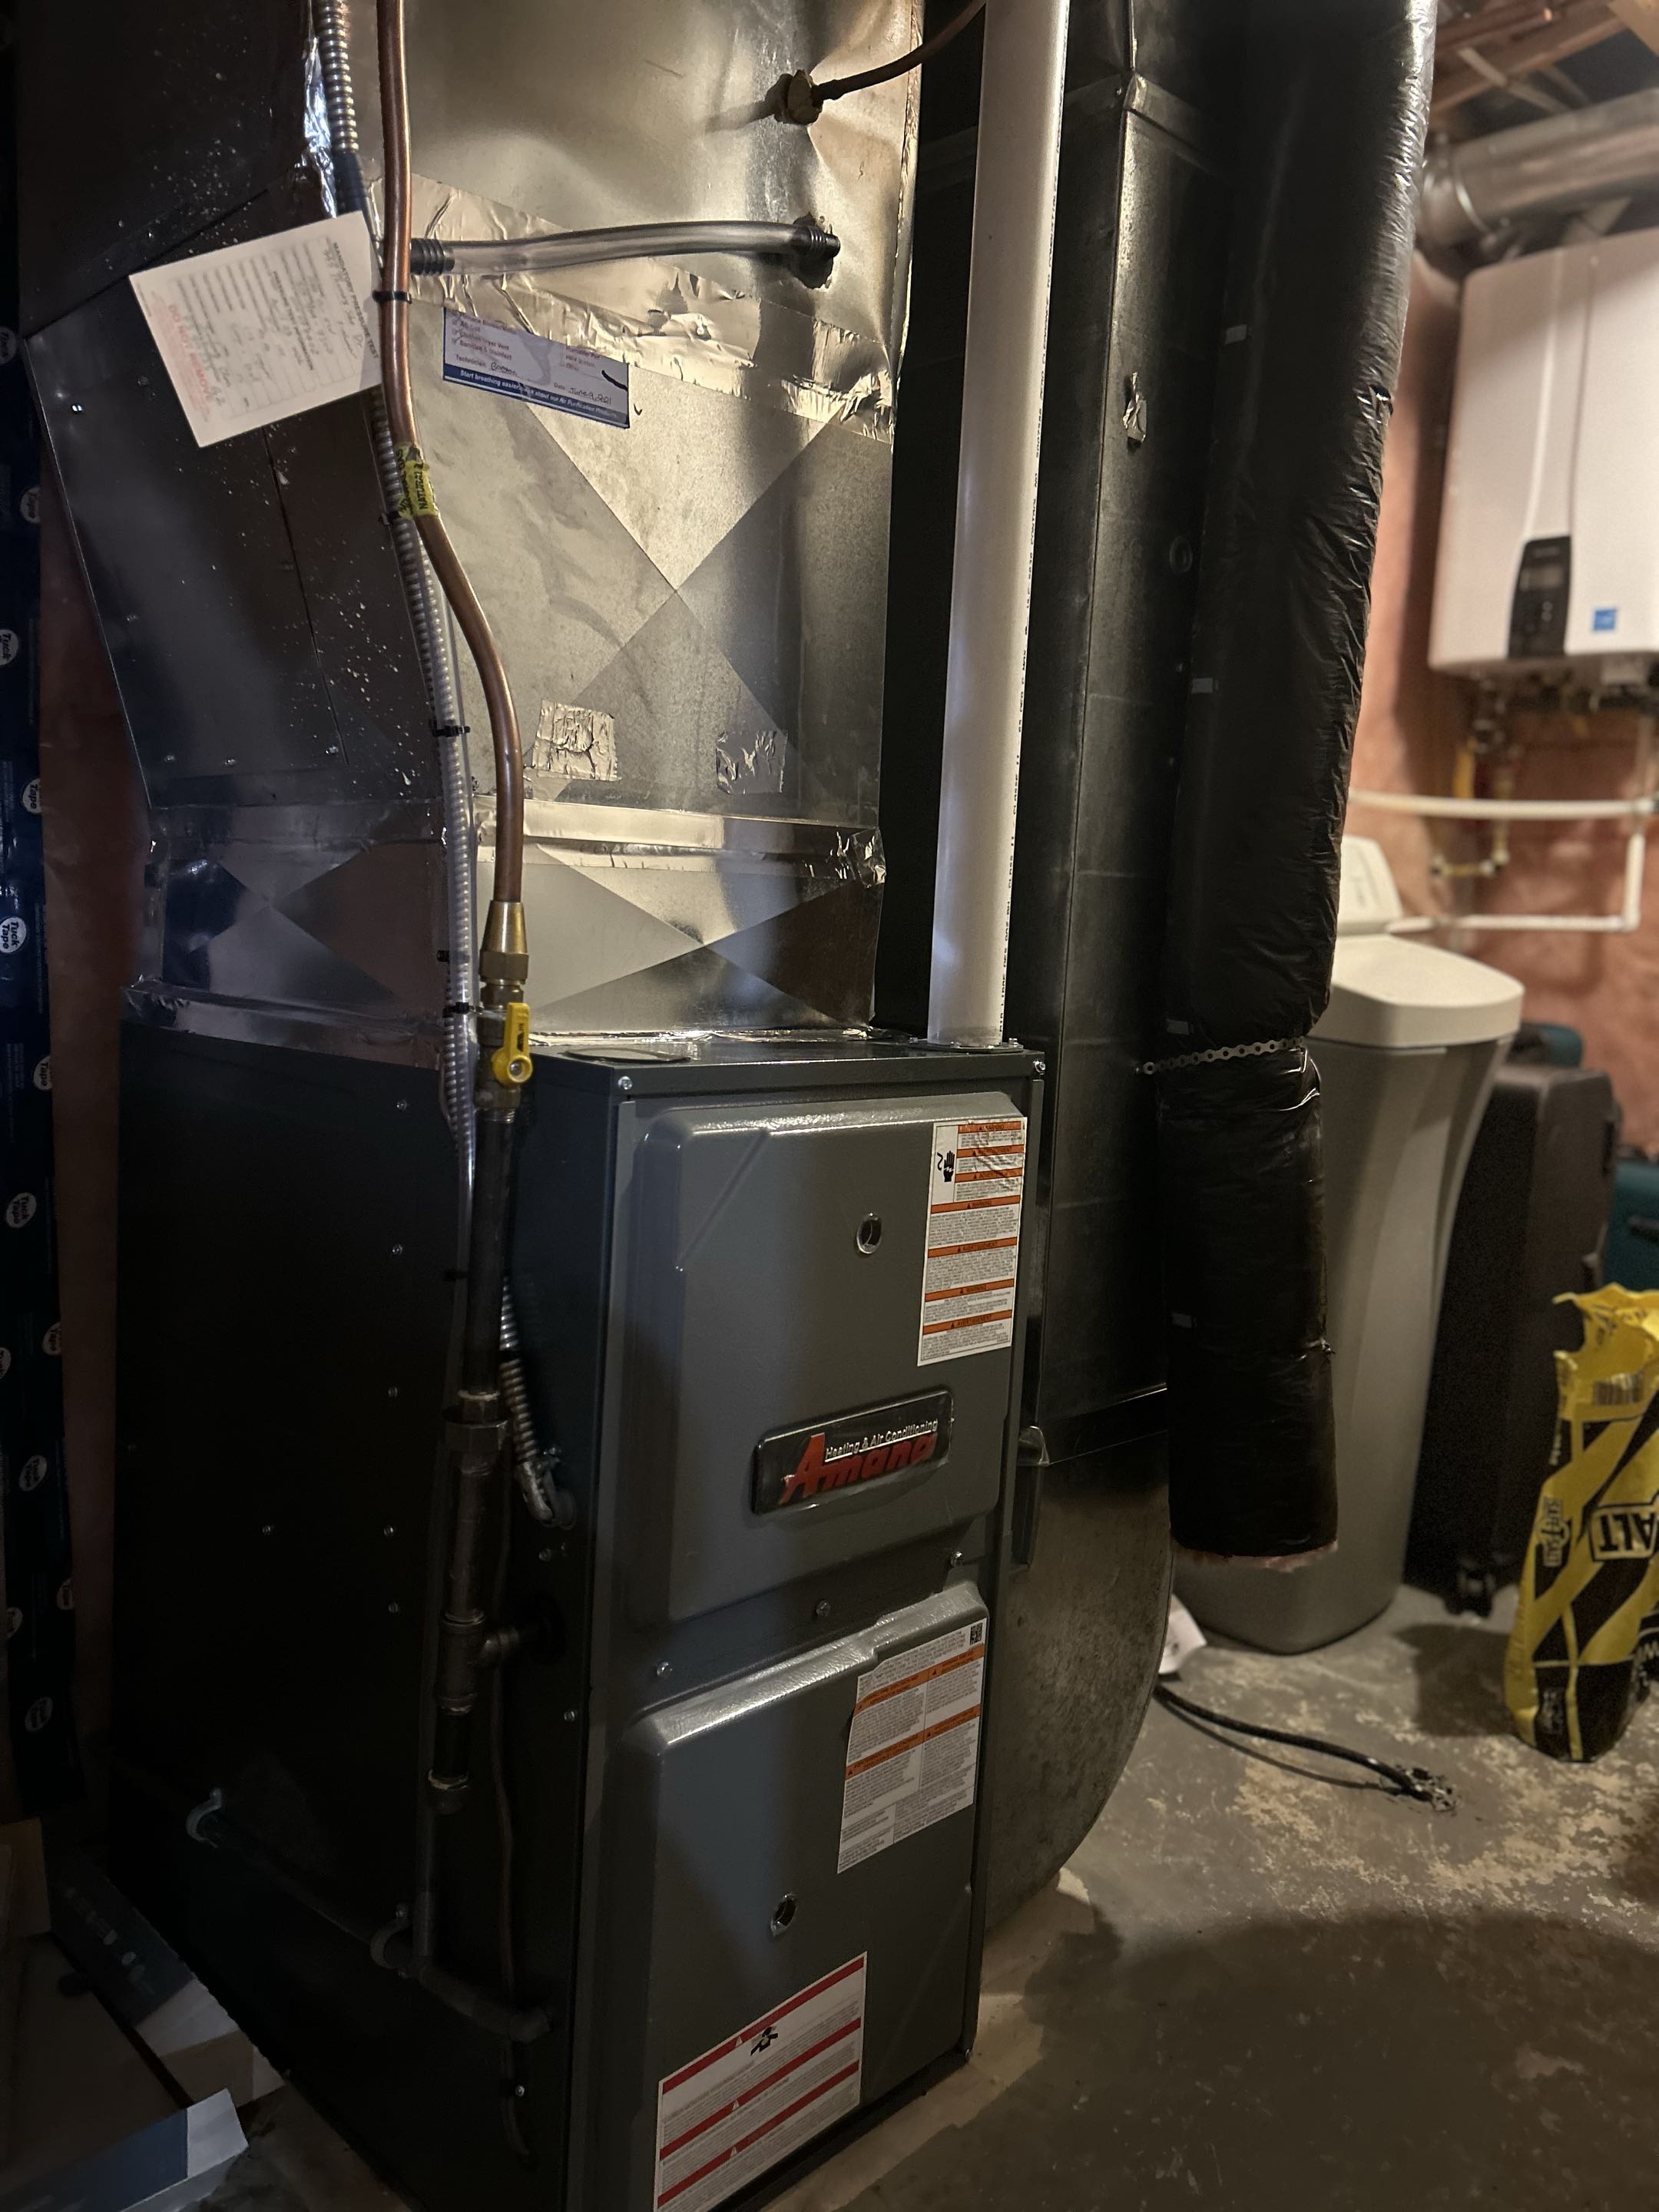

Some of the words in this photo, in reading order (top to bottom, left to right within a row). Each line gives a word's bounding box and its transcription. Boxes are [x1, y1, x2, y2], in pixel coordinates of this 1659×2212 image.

[332, 241, 354, 294] MANDATORY
[350, 293, 370, 338] PRESSURE
[366, 338, 379, 359] TEST
[286, 308, 296, 325] TEST
[167, 303, 183, 323] DO
[177, 324, 193, 349] NOT
[187, 352, 214, 402] REMOVE
[498, 342, 510, 350] Vent
[460, 369, 475, 378] Start
[475, 374, 502, 387] breathing
[414, 471, 428, 510] NATURAL
[2, 632, 12, 660] Tuck
[28, 783, 39, 810] Tape
[0, 923, 11, 949] Tape
[10, 920, 20, 946] Tuck
[39, 1061, 49, 1087] Tape
[826, 1441, 860, 1459] Heating
[861, 1438, 869, 1449] &
[870, 1434, 884, 1447] Air
[885, 1419, 939, 1442] Conditioning
[778, 1432, 939, 1505] Amana
